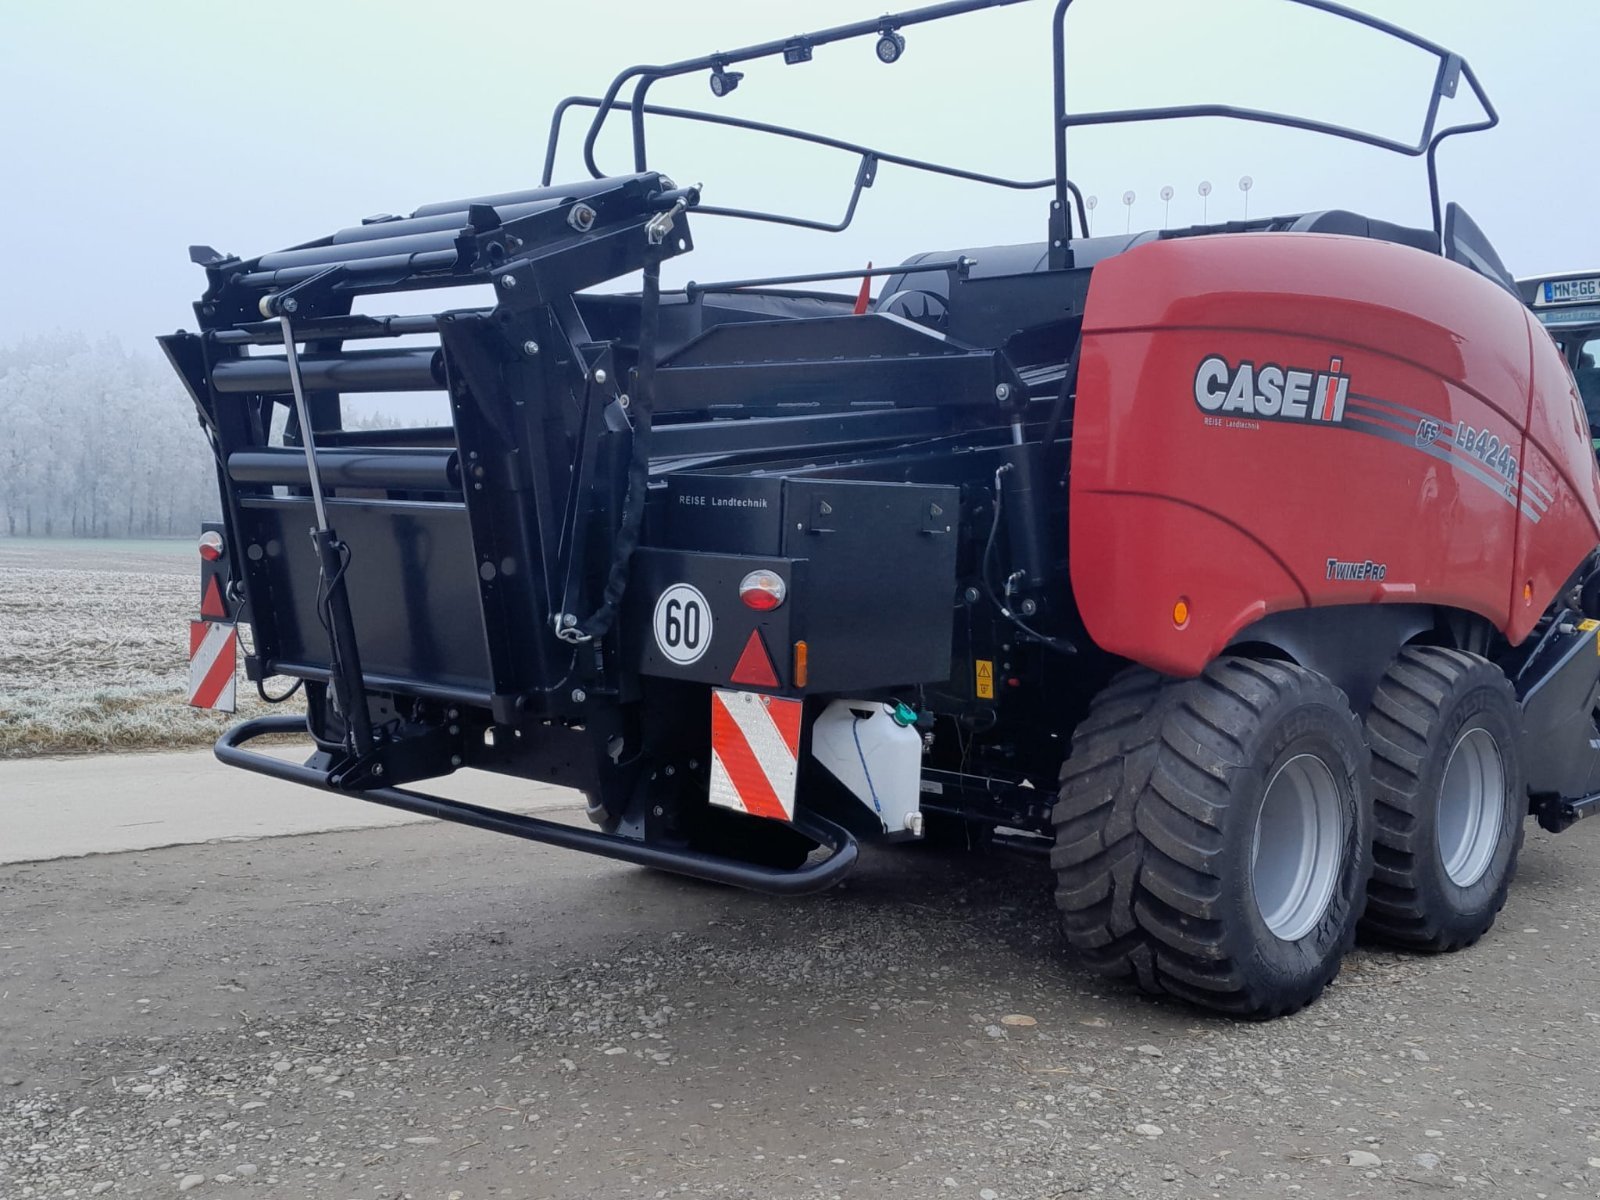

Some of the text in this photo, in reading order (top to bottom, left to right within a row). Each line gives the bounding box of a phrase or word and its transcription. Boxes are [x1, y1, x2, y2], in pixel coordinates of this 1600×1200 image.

[1553, 282, 1570, 297] MN
[1580, 280, 1596, 295] GG
[1416, 419, 1440, 442] AFS
[1455, 420, 1517, 481] LB424R
[679, 495, 768, 509] REISE Landtechnik
[665, 598, 701, 650] 60
